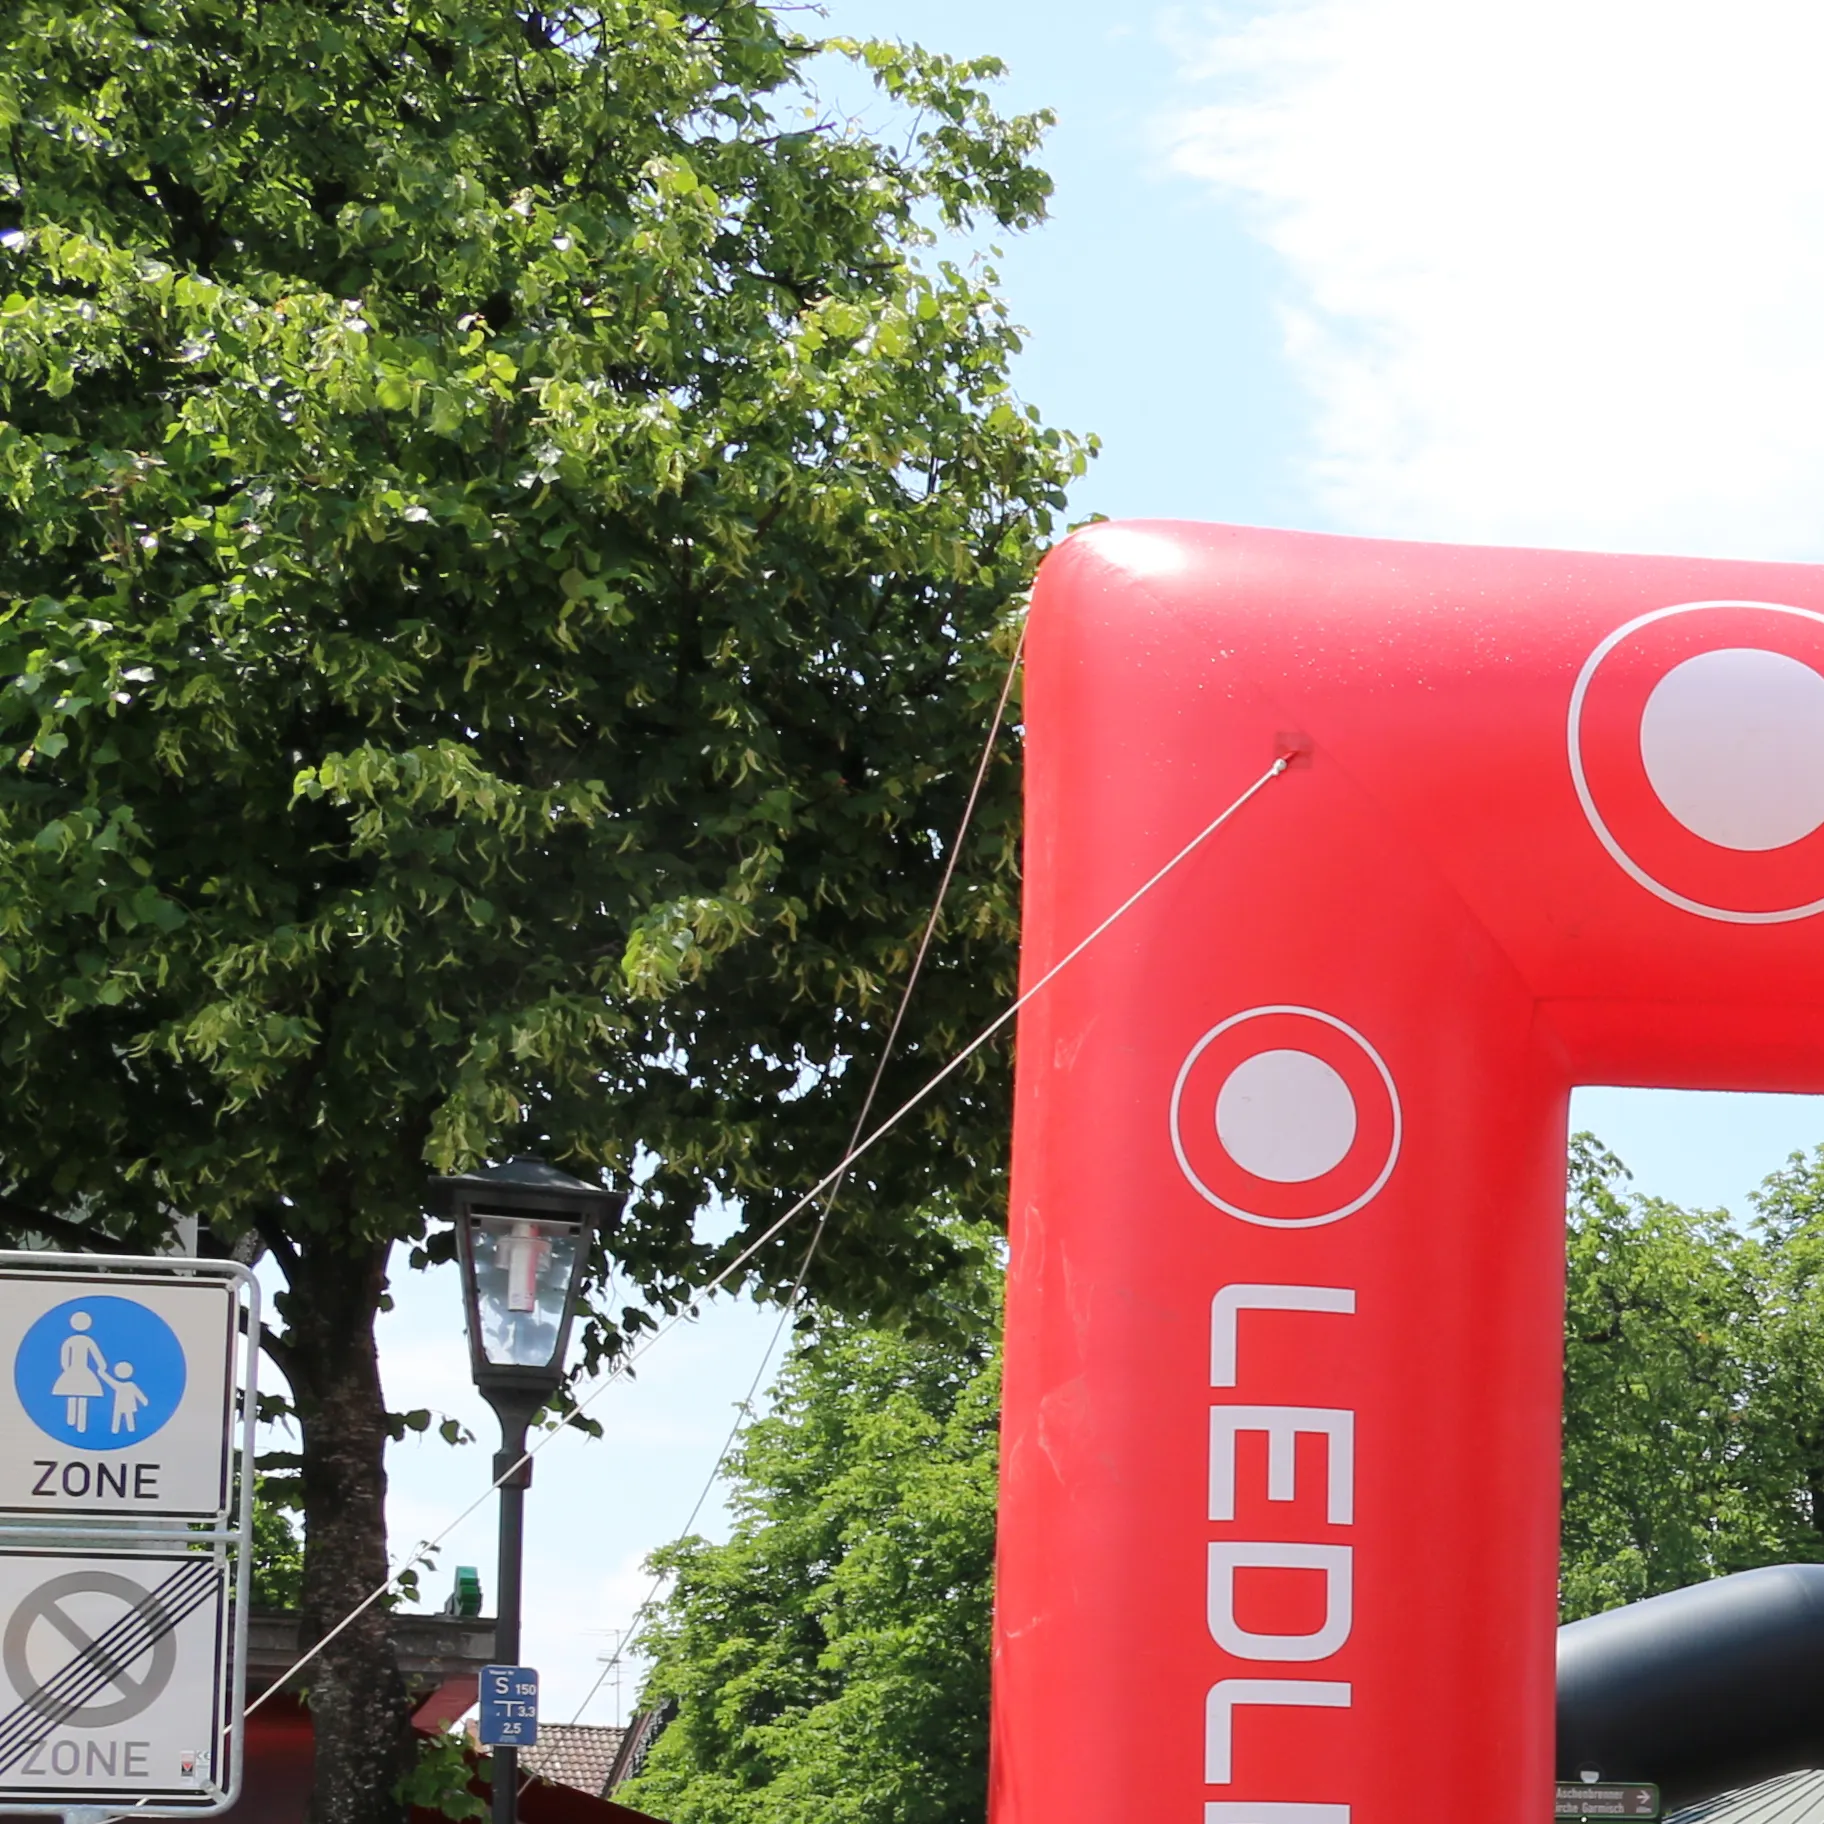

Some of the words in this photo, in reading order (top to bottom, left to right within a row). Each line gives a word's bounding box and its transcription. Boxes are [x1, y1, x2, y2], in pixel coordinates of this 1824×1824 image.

[31, 1460, 161, 1499] ZONE
[515, 1683, 537, 1696] 150
[20, 1739, 151, 1777] ZONE
[1555, 1803, 1579, 1814] irche
